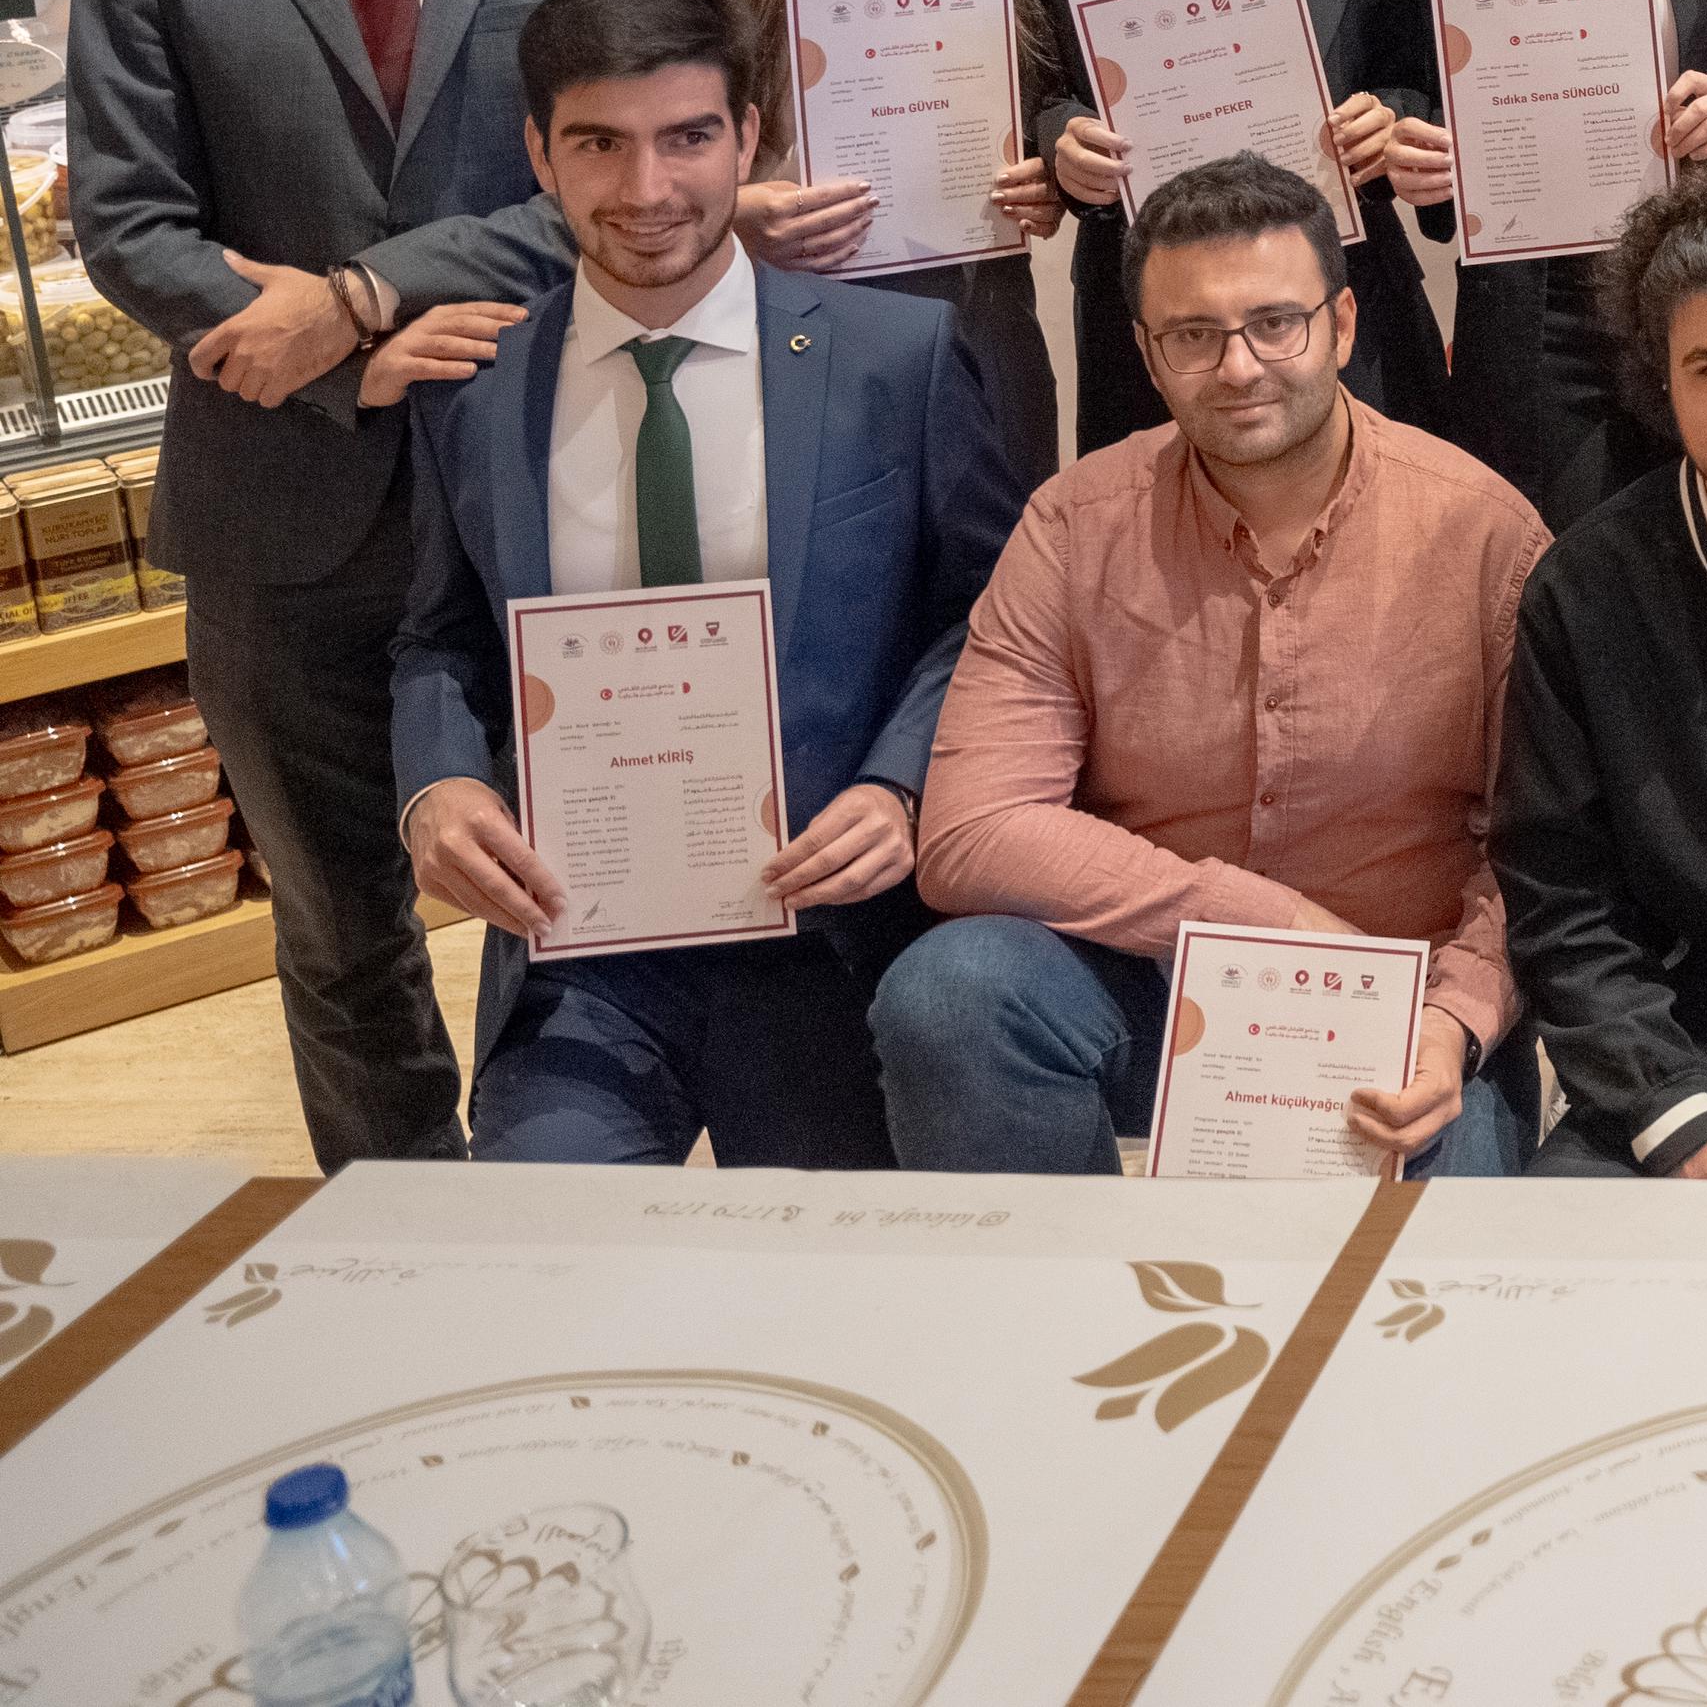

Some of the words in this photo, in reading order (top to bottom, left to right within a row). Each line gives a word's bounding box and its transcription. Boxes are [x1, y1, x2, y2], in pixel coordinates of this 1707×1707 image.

[1530, 90, 1560, 103] Sena
[1562, 83, 1621, 100] SÜNGÜCÜ
[871, 103, 906, 119] Kübra
[908, 98, 951, 115] GÜVEN
[1183, 110, 1213, 126] Buse
[1215, 98, 1254, 118] PEKER
[609, 753, 656, 770] Ahmet
[657, 748, 695, 768] KİRİŞ
[1224, 1090, 1268, 1106] Ahmet
